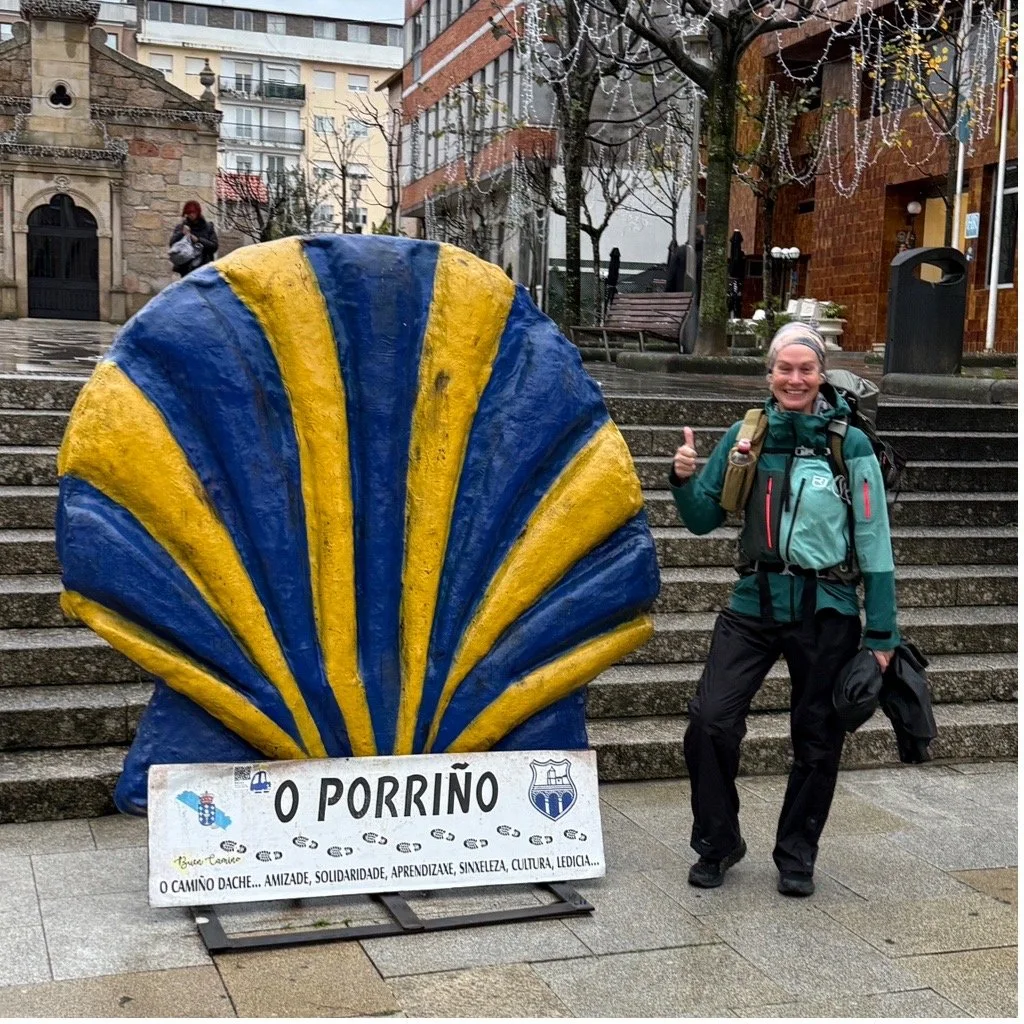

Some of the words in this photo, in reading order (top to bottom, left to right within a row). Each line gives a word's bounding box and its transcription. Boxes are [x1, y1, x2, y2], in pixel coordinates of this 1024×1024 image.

[275, 780, 299, 823] O
[318, 762, 499, 821] PORRIÑO
[160, 881, 168, 893] O
[171, 876, 215, 892] CAMIÑO
[218, 876, 261, 890] DACHE...
[264, 871, 312, 886] AMIZADE,
[315, 865, 388, 884] SOLIDARIDADE,
[391, 862, 457, 878] APRENDIZAXE,
[459, 859, 509, 874] SINXELEZA,
[511, 857, 555, 870] CULTURA,
[557, 854, 600, 868] LEDICIA...
